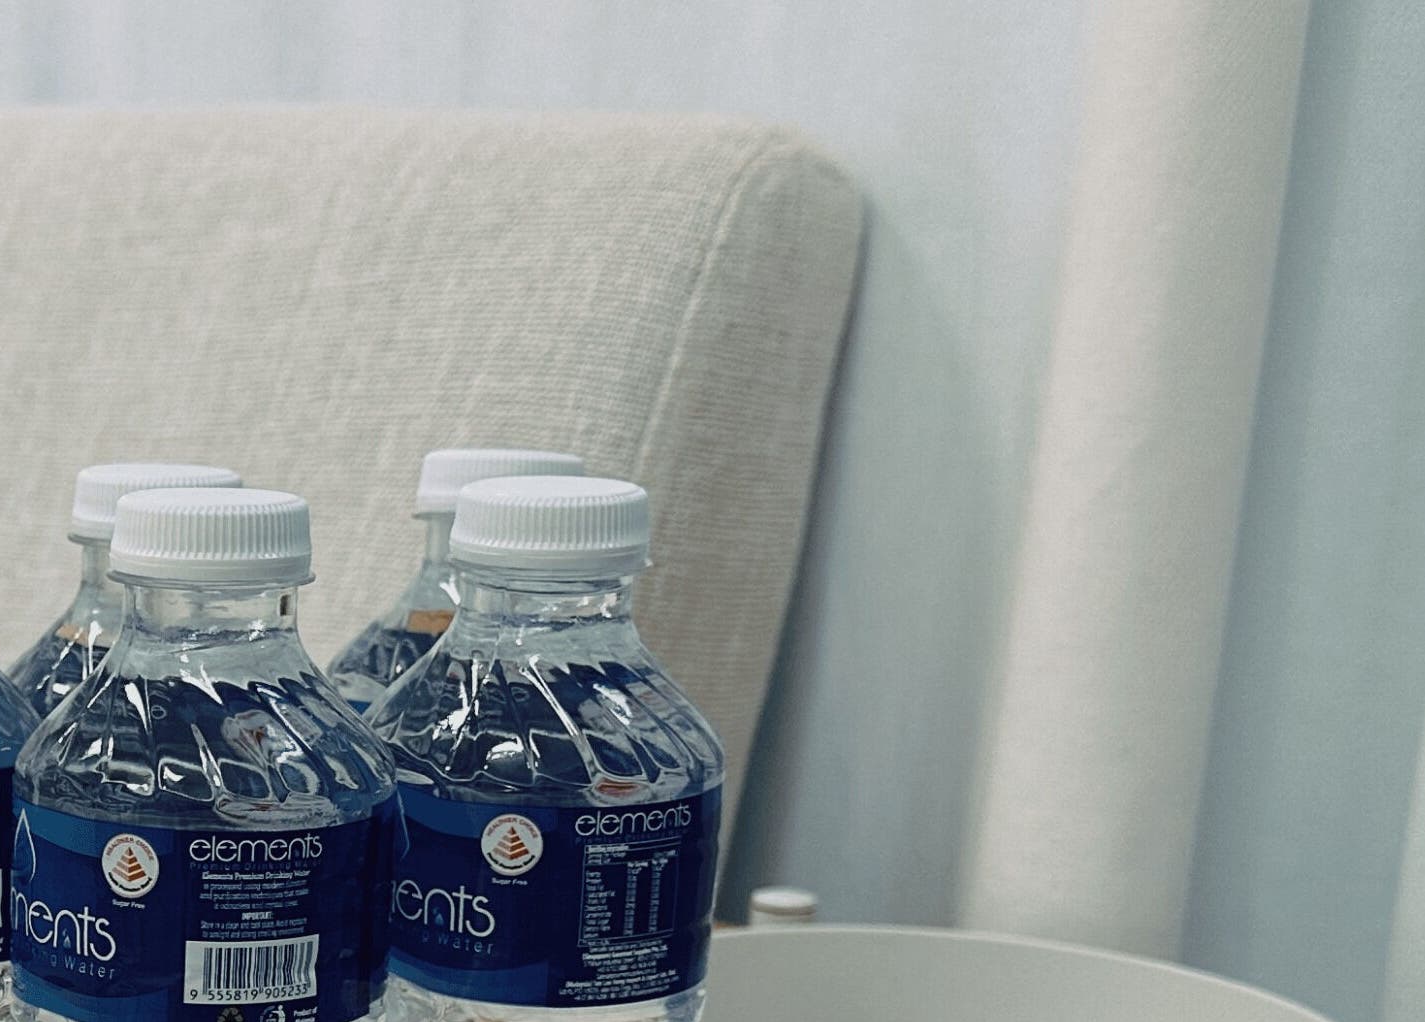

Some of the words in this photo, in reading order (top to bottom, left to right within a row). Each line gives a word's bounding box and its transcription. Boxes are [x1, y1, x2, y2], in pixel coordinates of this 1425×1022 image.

[575, 803, 691, 836] elements
[189, 833, 322, 862] elements
[64, 955, 120, 980] Water
[190, 989, 198, 1000] 9
[208, 989, 258, 1001] 555819
[265, 983, 308, 999] 905233
